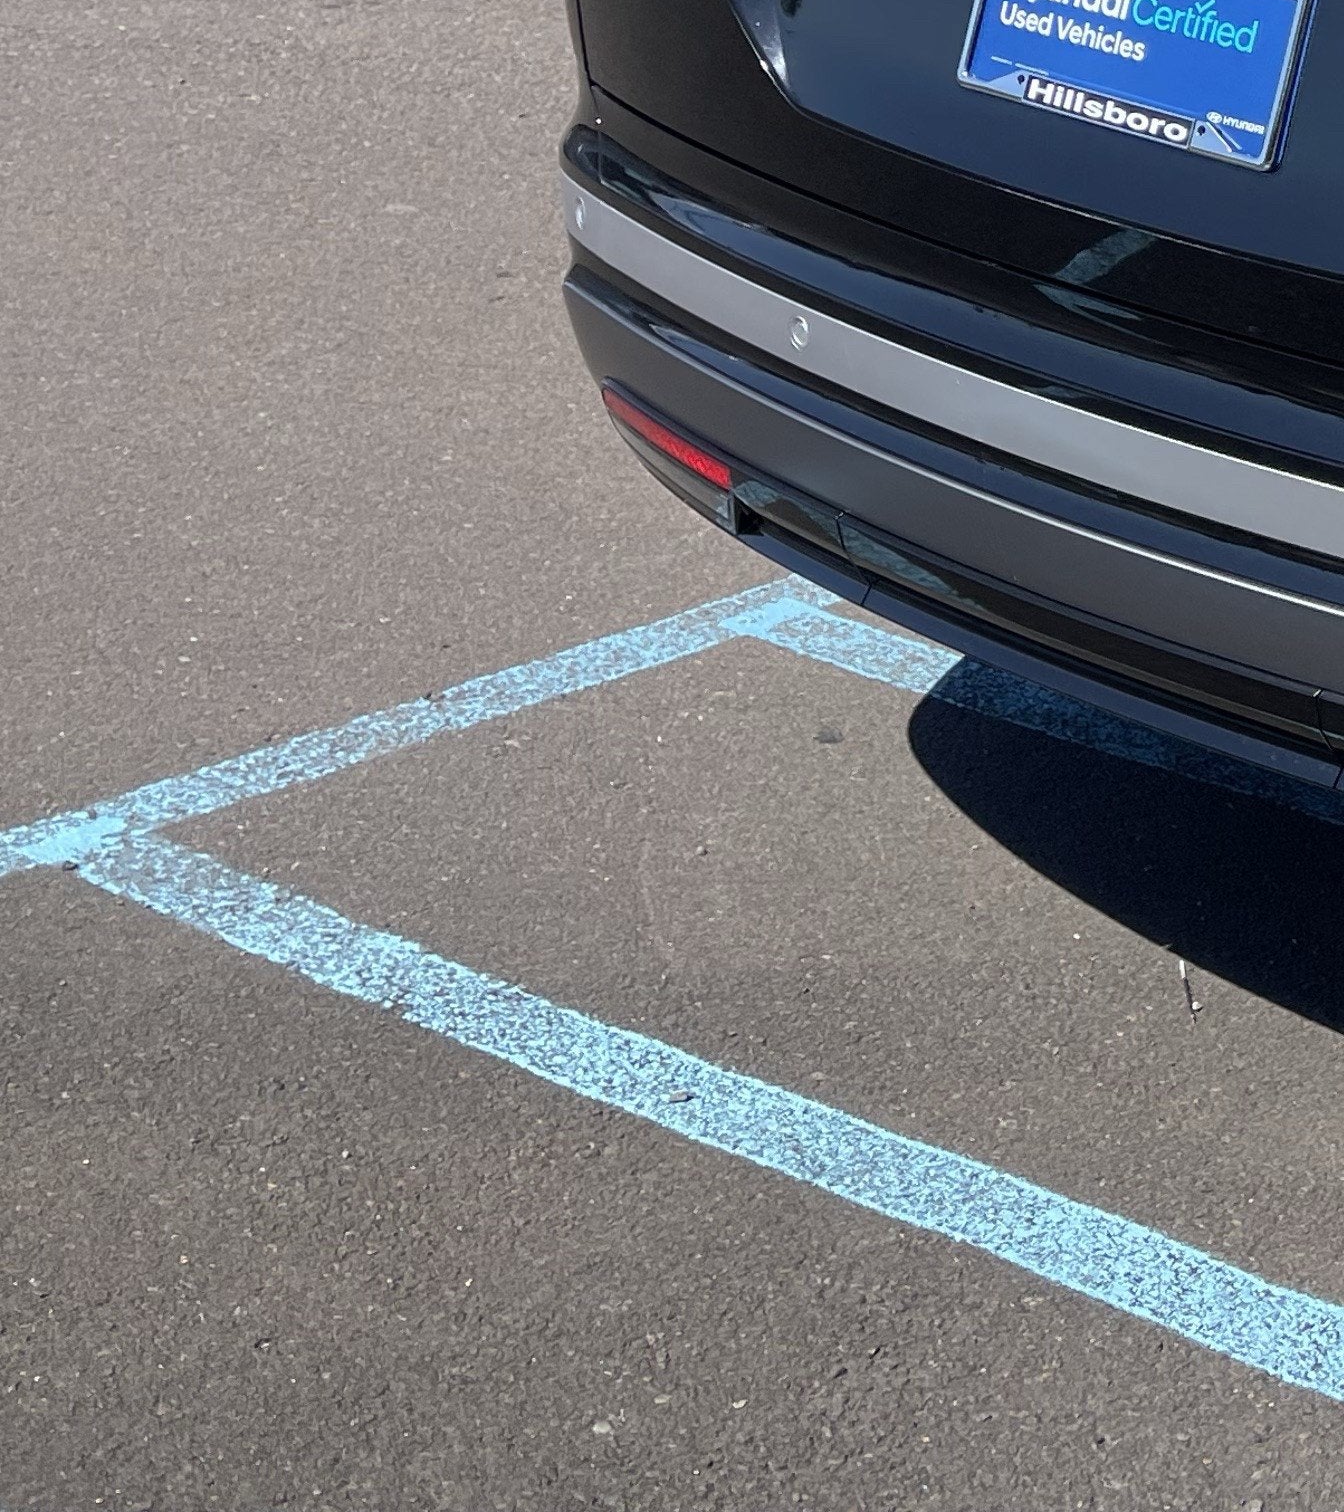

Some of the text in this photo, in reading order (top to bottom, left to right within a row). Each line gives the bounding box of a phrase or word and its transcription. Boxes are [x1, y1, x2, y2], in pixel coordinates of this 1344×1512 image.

[1000, 0, 1147, 61] Used Vehicles
[1027, 76, 1188, 143] Hillsboro
[1222, 115, 1265, 135] HYUNDAI
